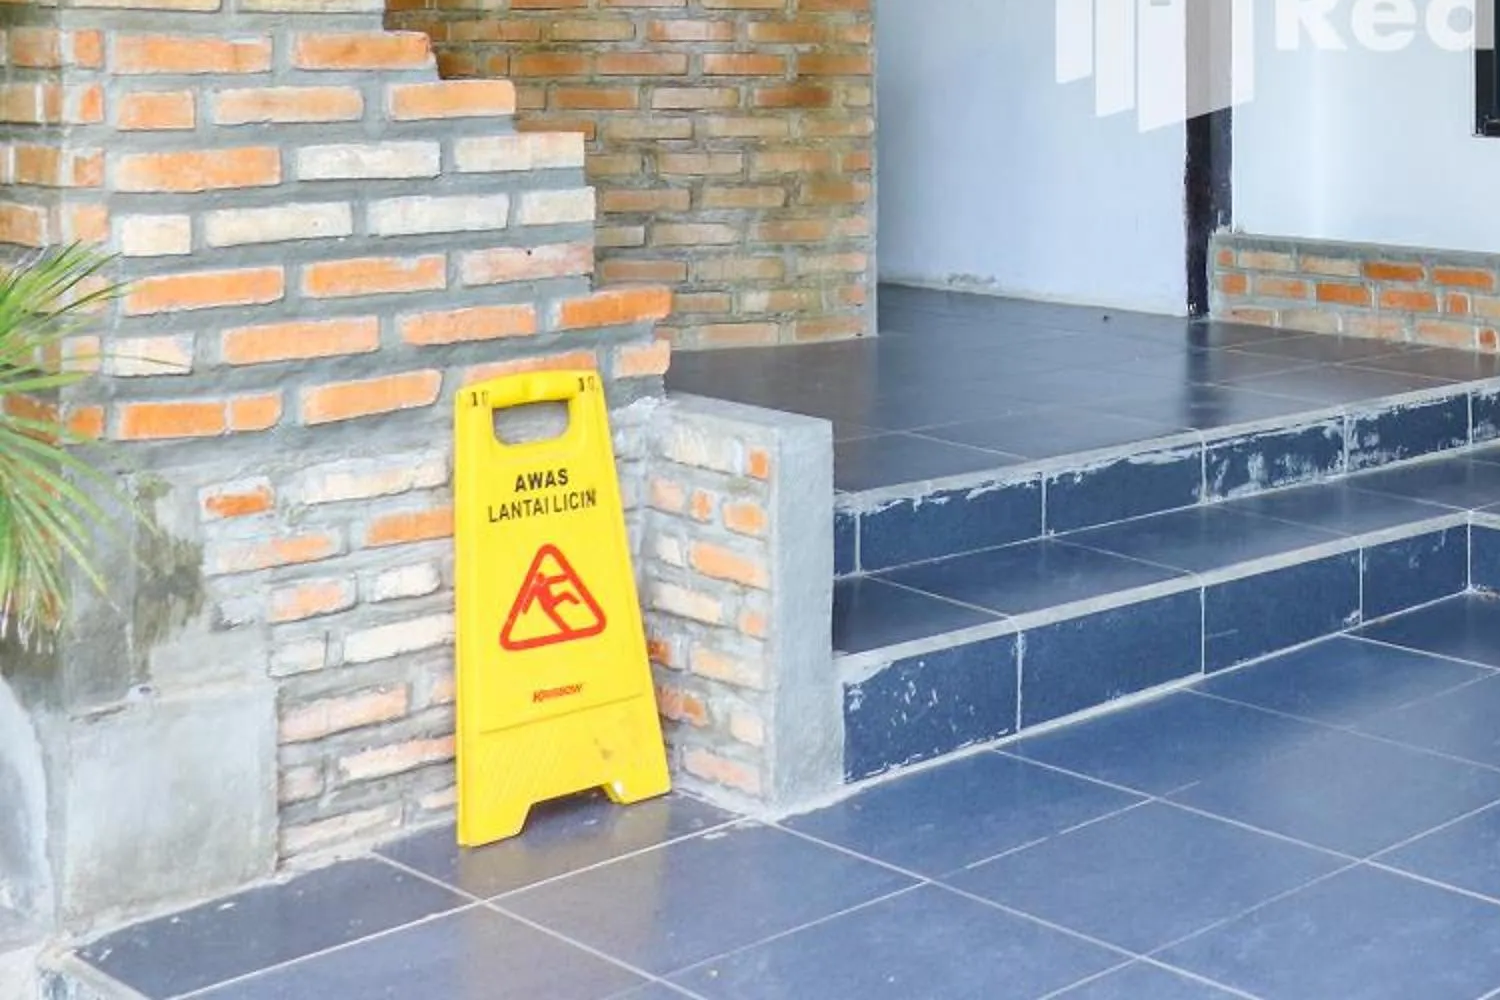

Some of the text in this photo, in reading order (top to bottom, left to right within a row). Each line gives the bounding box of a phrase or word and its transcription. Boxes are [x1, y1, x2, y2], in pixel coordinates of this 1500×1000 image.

[514, 467, 569, 493] AWAS
[487, 487, 598, 523] LANTAI LICIN
